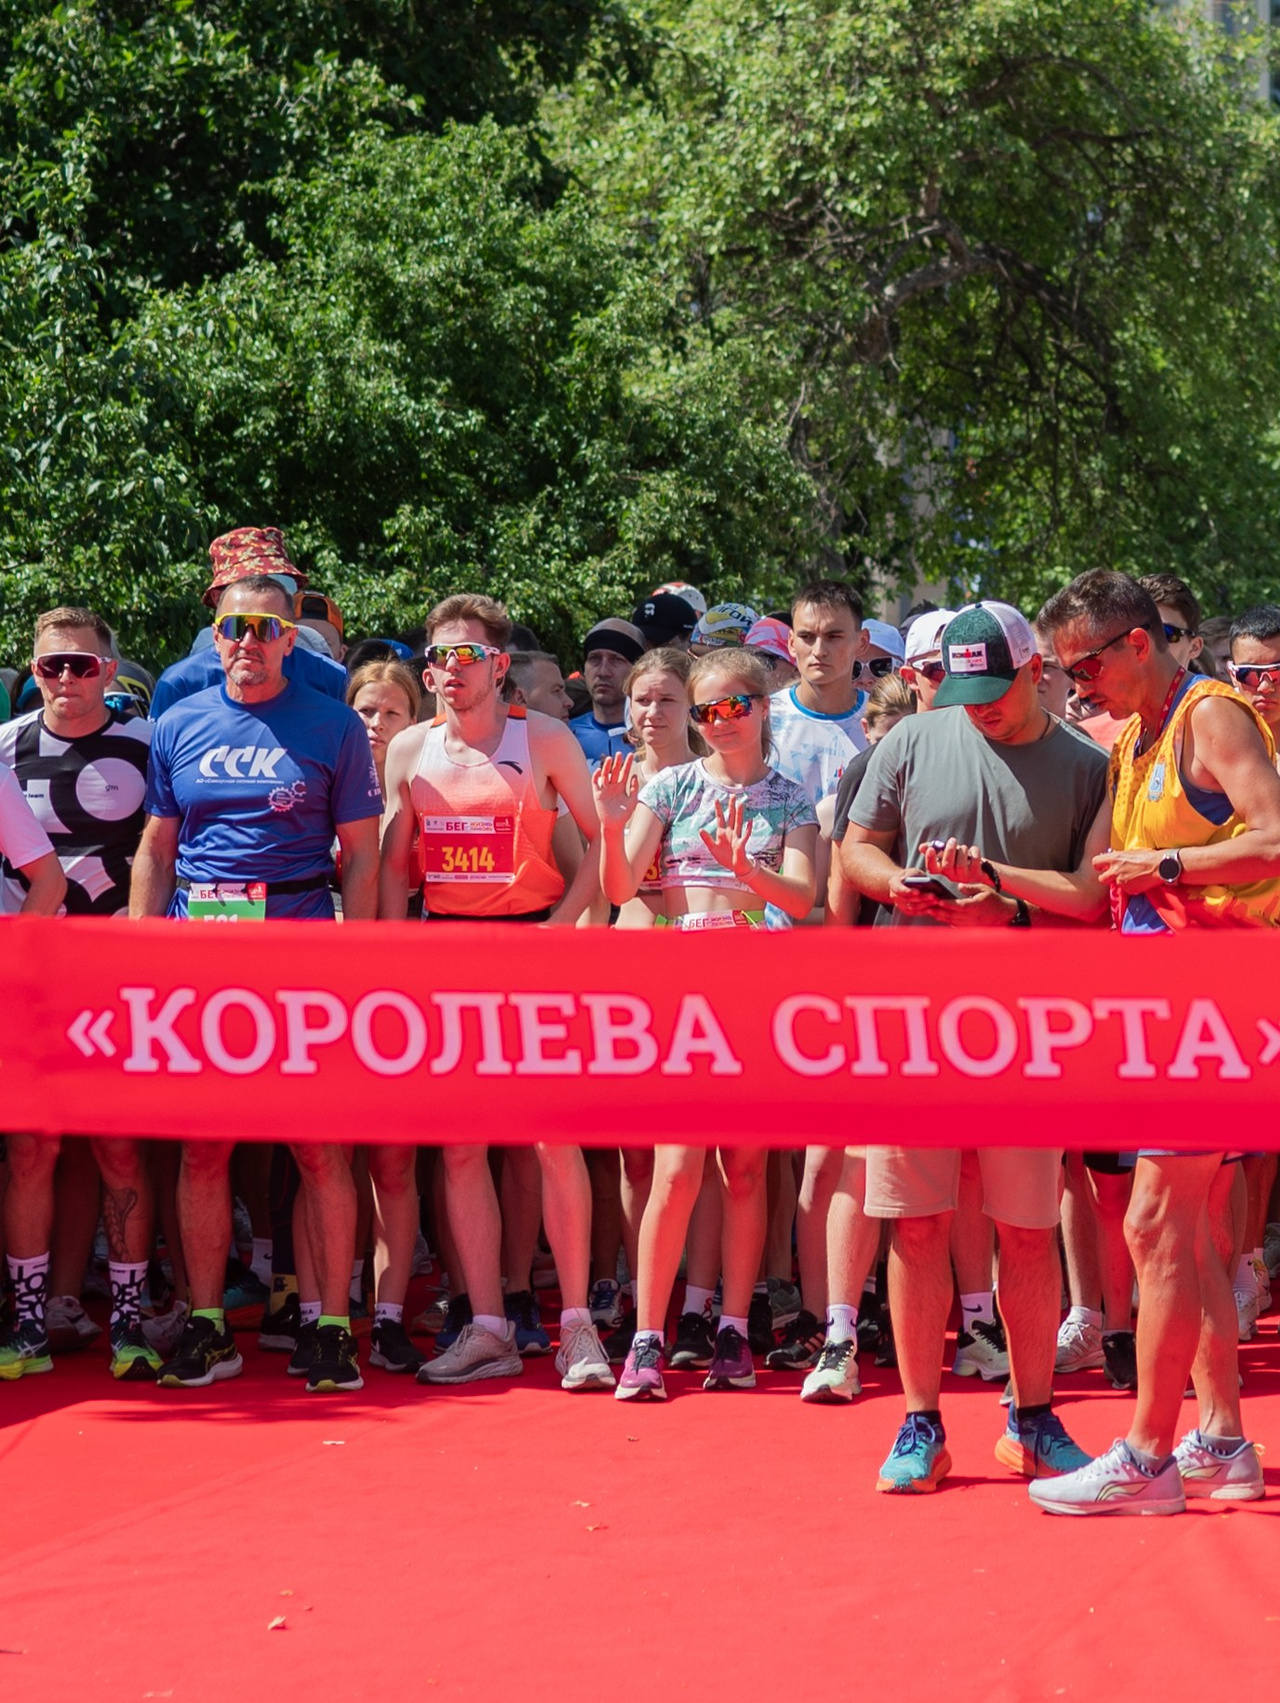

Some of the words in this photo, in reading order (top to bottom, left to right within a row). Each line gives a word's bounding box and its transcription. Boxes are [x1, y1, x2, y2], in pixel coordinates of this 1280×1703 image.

[446, 822, 467, 831] БЕГ
[441, 846, 496, 872] 3414
[689, 918, 708, 928] БЕГ
[66, 987, 742, 1076] «КОРОЛЕВА
